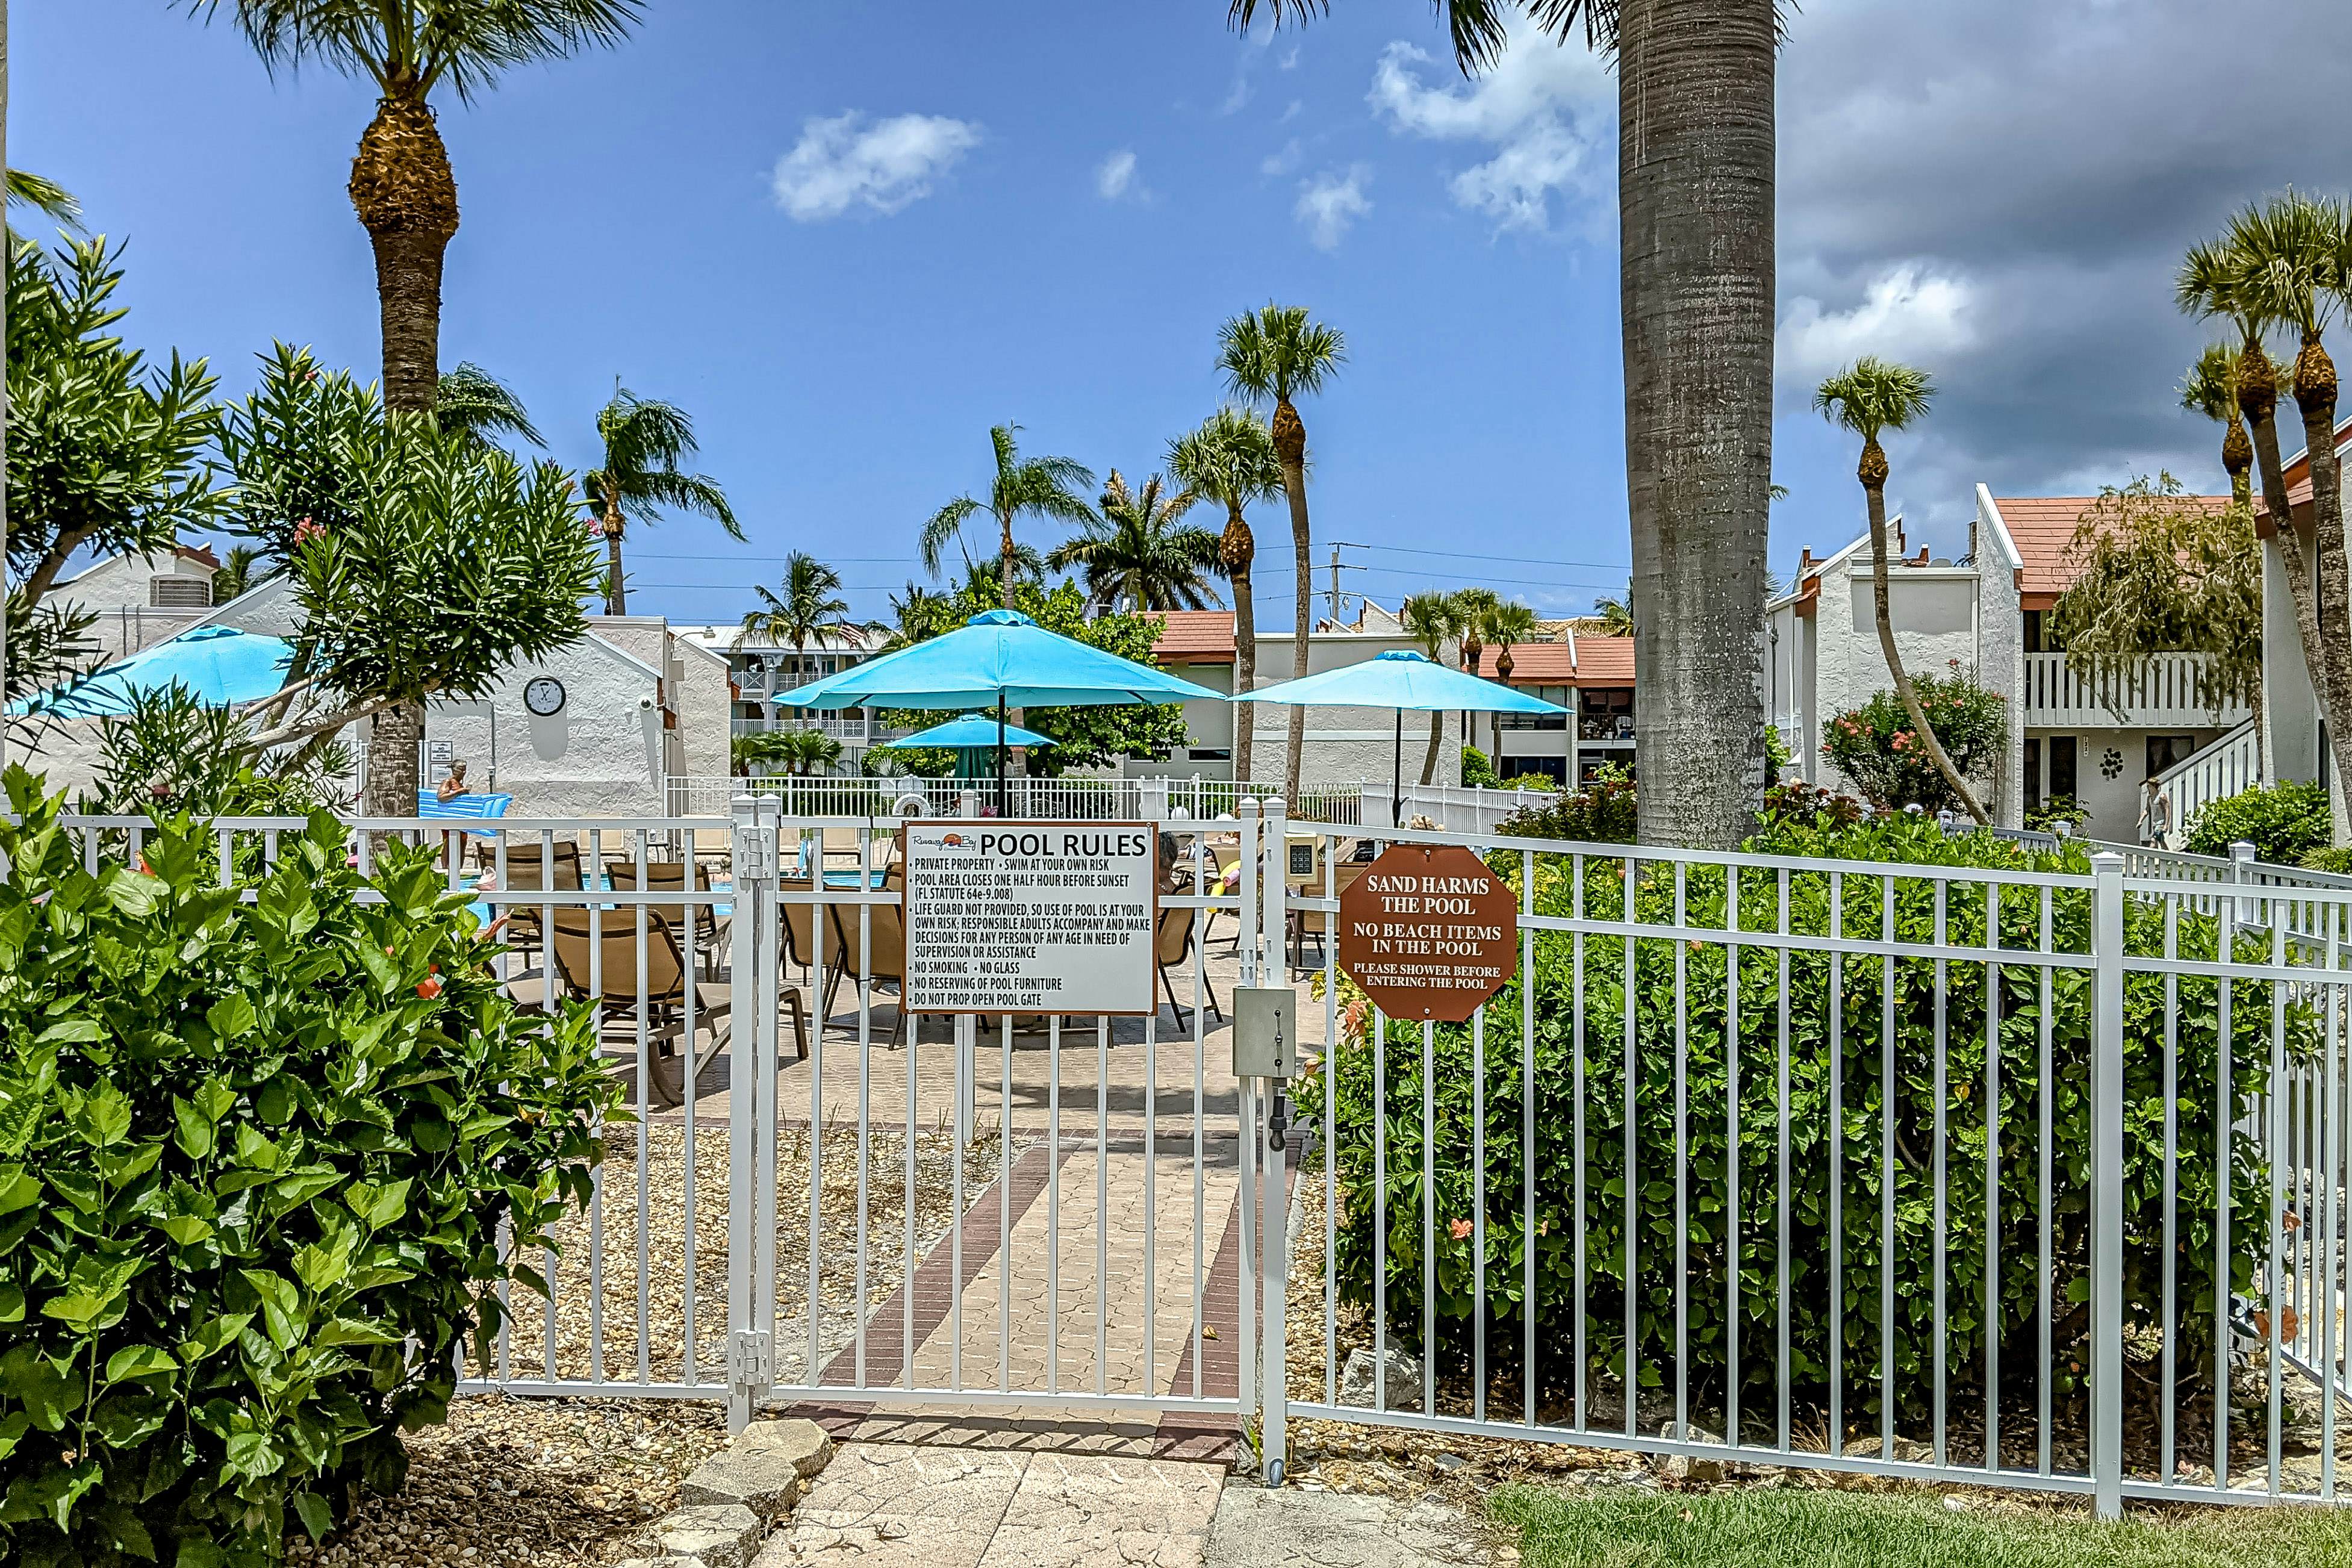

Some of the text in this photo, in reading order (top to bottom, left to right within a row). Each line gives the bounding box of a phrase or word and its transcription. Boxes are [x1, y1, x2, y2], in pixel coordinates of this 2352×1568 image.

[961, 835, 977, 851] Bay
[980, 833, 1146, 857] POOL RULES
[915, 857, 1109, 871] PRIVATE PROPERTY SWIM AT YOUR OWN RISK
[915, 873, 1130, 888] POOL AREA CLOSES ONE HALF HOUR BEFORE SUNSET
[1367, 875, 1489, 895] SAND HARMS
[915, 886, 1013, 902] (FL STATUTE 64e-9.008)
[915, 903, 1144, 918] LIFE GUARD NOT PROVIDED, SO USE OF POOL IS AT YOUR
[1381, 896, 1476, 915] THE POOL
[915, 916, 1150, 931] OWN RISK; RESPONSIBLE ADULTS ACCOMPANY AND MAKE
[915, 931, 1130, 945] DECISIONS FOR ANY PERSON OF ANY AGE IN NEED OF
[1354, 922, 1501, 941] NO BEACH ITEMS
[915, 945, 1036, 959] SUPERVISION OR ASSISTANCE
[1372, 939, 1482, 956] IN THE POOL
[914, 960, 1020, 974] NO SMOKING NO GLASS
[1354, 962, 1501, 978] PLEASE SHOWER BEFORE
[914, 977, 1062, 991] NO RESERVING OF POOL FURNITURE
[1366, 975, 1488, 989] ENTERING THE POOL
[914, 992, 1042, 1006] DO NOT PROP OPEN POOL GATE
